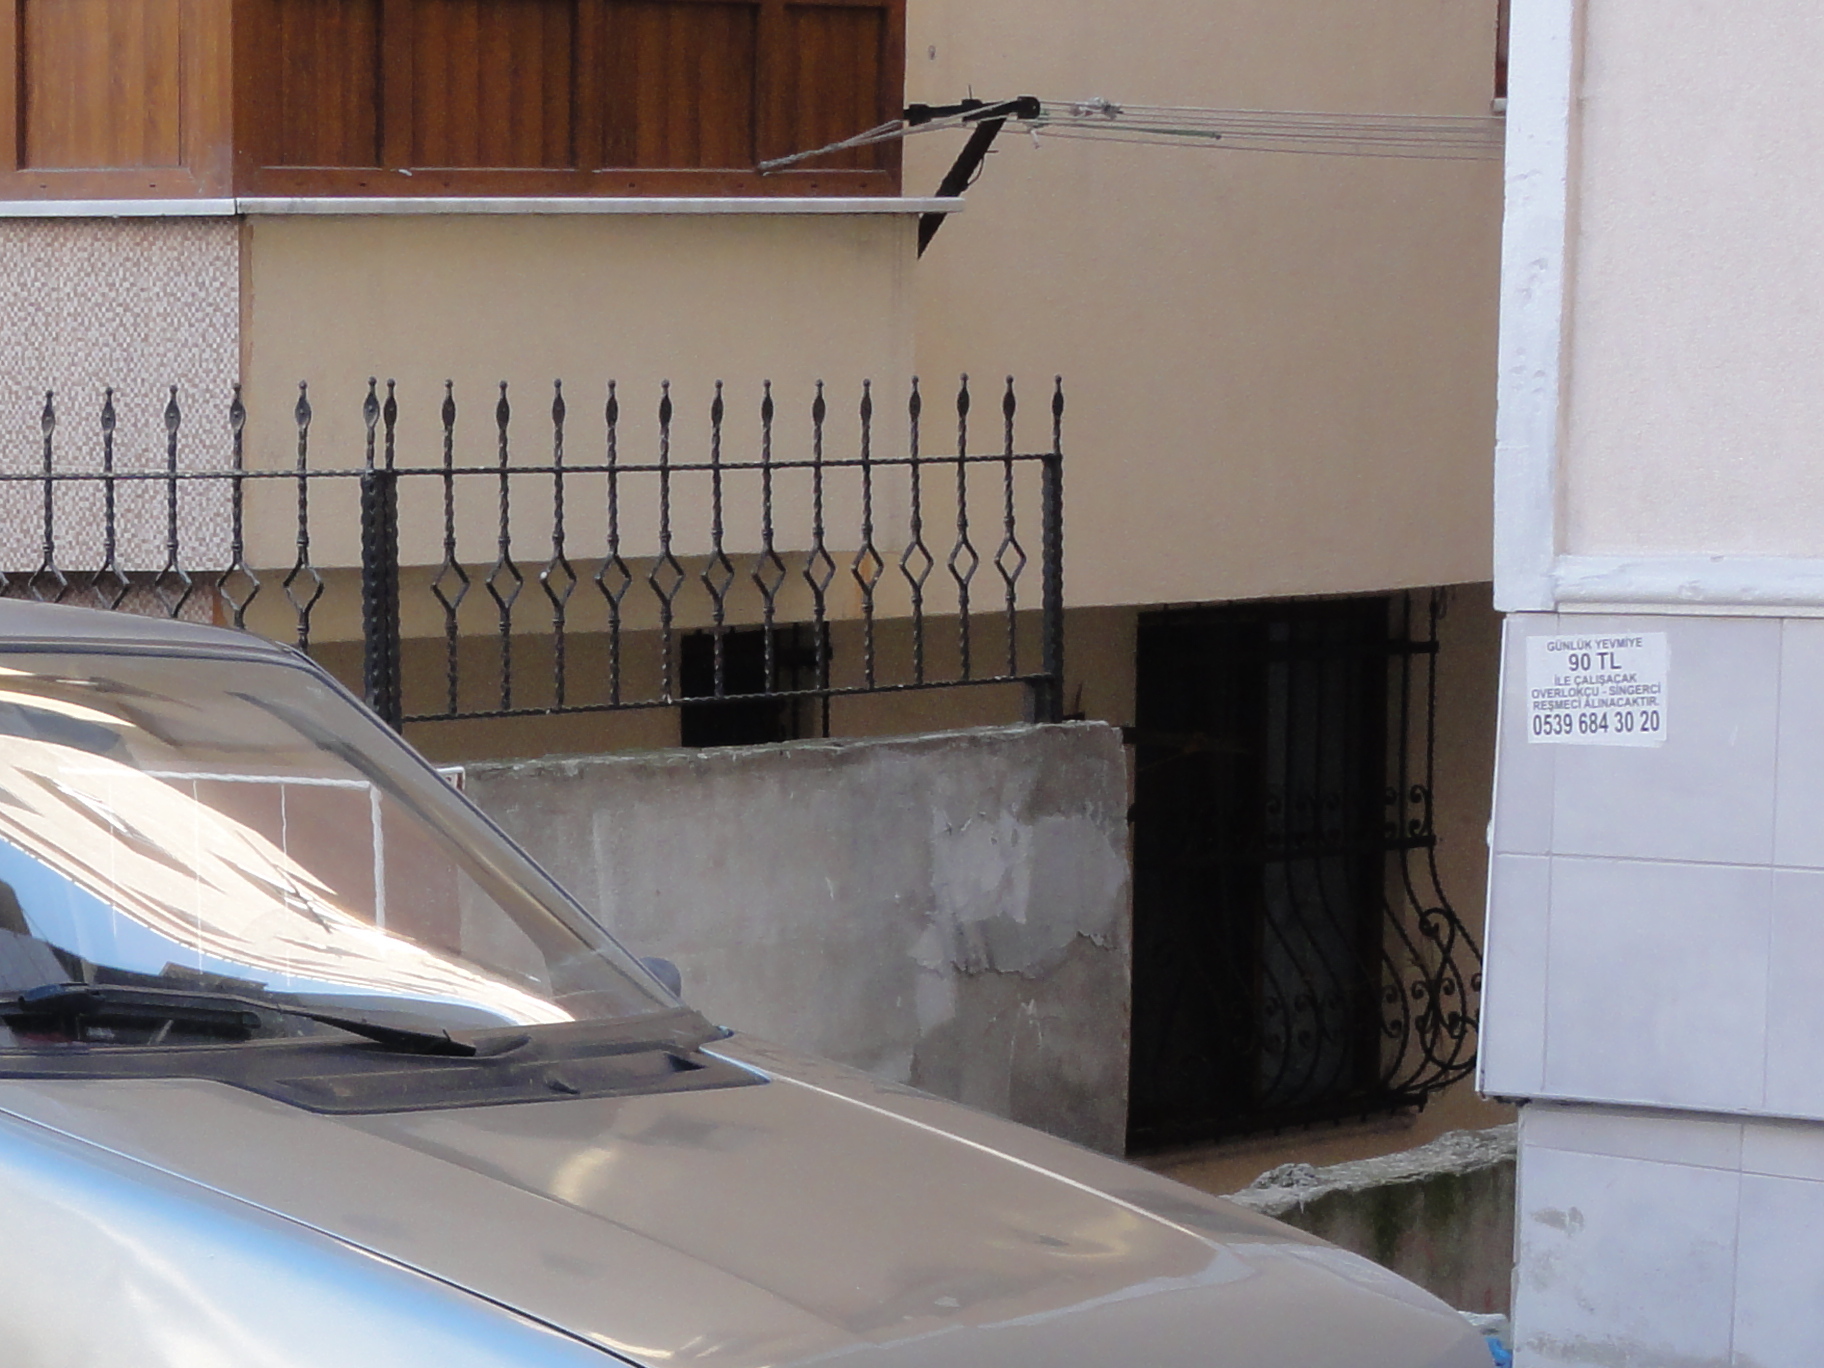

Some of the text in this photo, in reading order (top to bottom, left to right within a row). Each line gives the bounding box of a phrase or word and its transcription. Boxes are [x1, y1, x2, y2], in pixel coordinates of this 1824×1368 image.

[1547, 638, 1592, 651] GÜNLÜK
[1569, 652, 1622, 671] 90 TL
[1533, 710, 1660, 735] 0539 684 30 20
